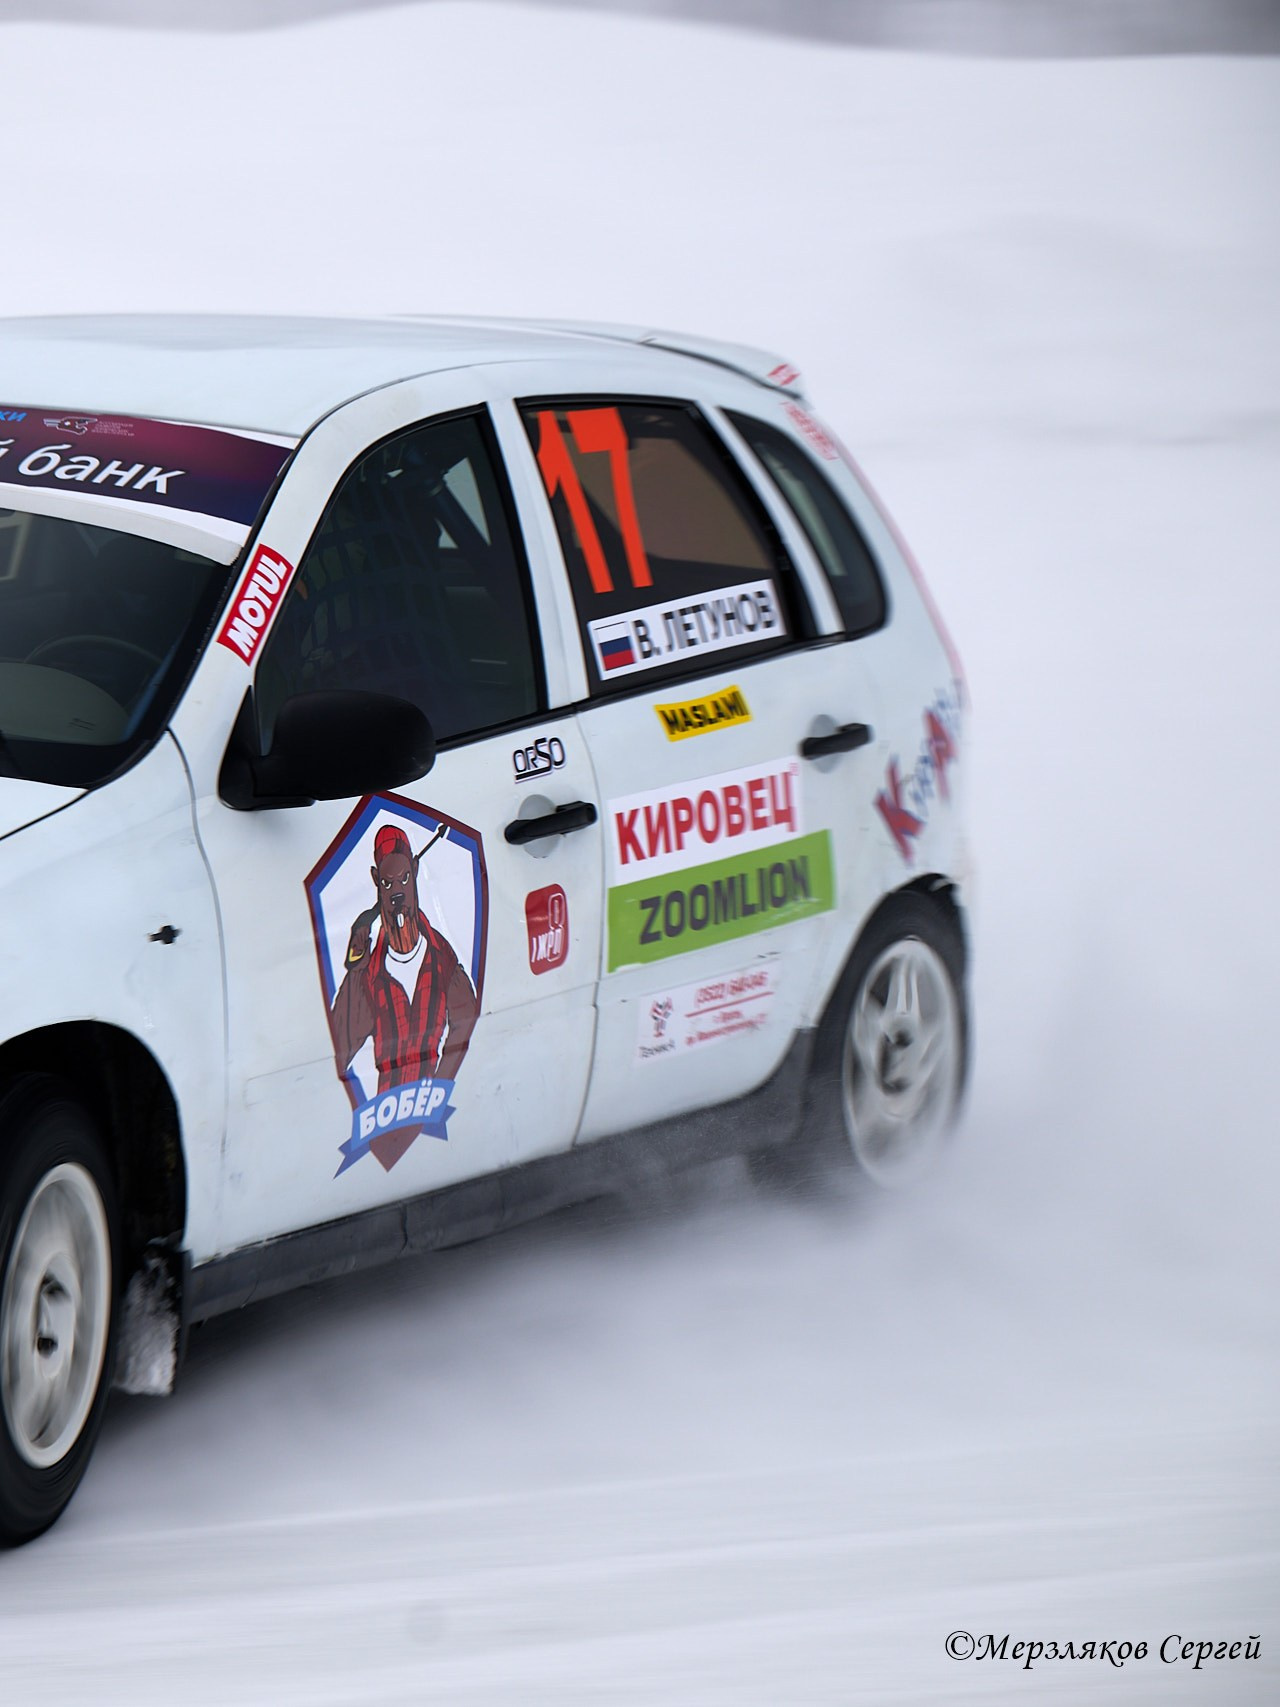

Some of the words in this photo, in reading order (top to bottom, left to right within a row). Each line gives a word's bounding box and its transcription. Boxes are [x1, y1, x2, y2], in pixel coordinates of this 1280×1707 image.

[19, 444, 186, 494] банк
[536, 407, 653, 594] 17
[226, 554, 288, 658] MOTUL
[662, 590, 776, 652] ЛЕТУНОВ
[615, 771, 797, 865] КИРОВЕЦ
[639, 855, 810, 945] ZOOMLION
[360, 1080, 446, 1140] БОБЁР
